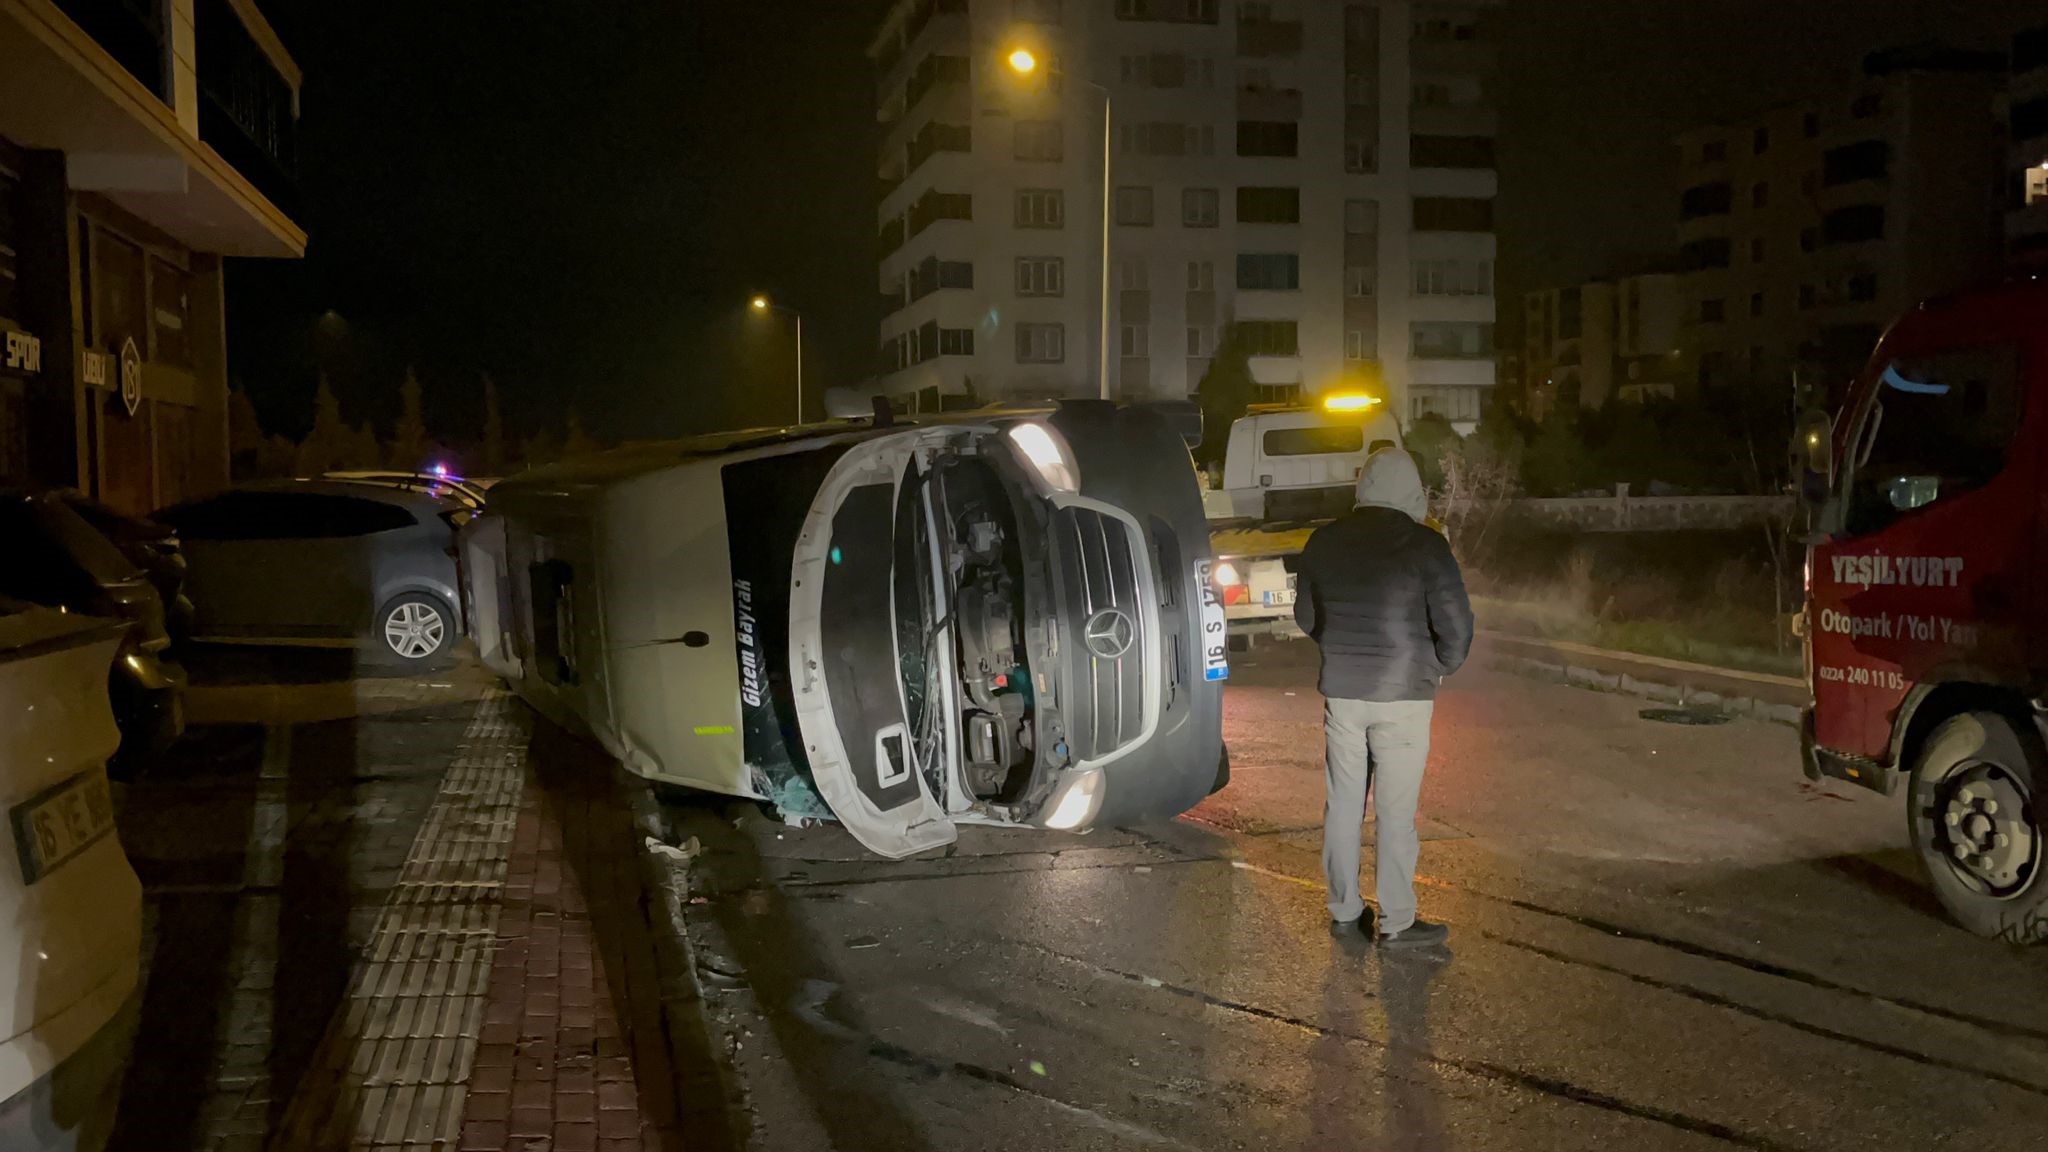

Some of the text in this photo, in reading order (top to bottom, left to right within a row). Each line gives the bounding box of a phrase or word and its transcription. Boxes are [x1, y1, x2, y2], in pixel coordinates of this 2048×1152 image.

[7, 331, 40, 373] SPOR
[1831, 549, 1964, 590] YEŞİLYURT
[1272, 592, 1283, 604] 16
[1206, 621, 1222, 633] S
[1821, 608, 1891, 638] Otopark
[1907, 615, 1935, 641] Yol
[734, 578, 761, 708] Gizem Bayrak
[1208, 645, 1226, 666] 16
[1820, 665, 1904, 690] 0224 240 11 05
